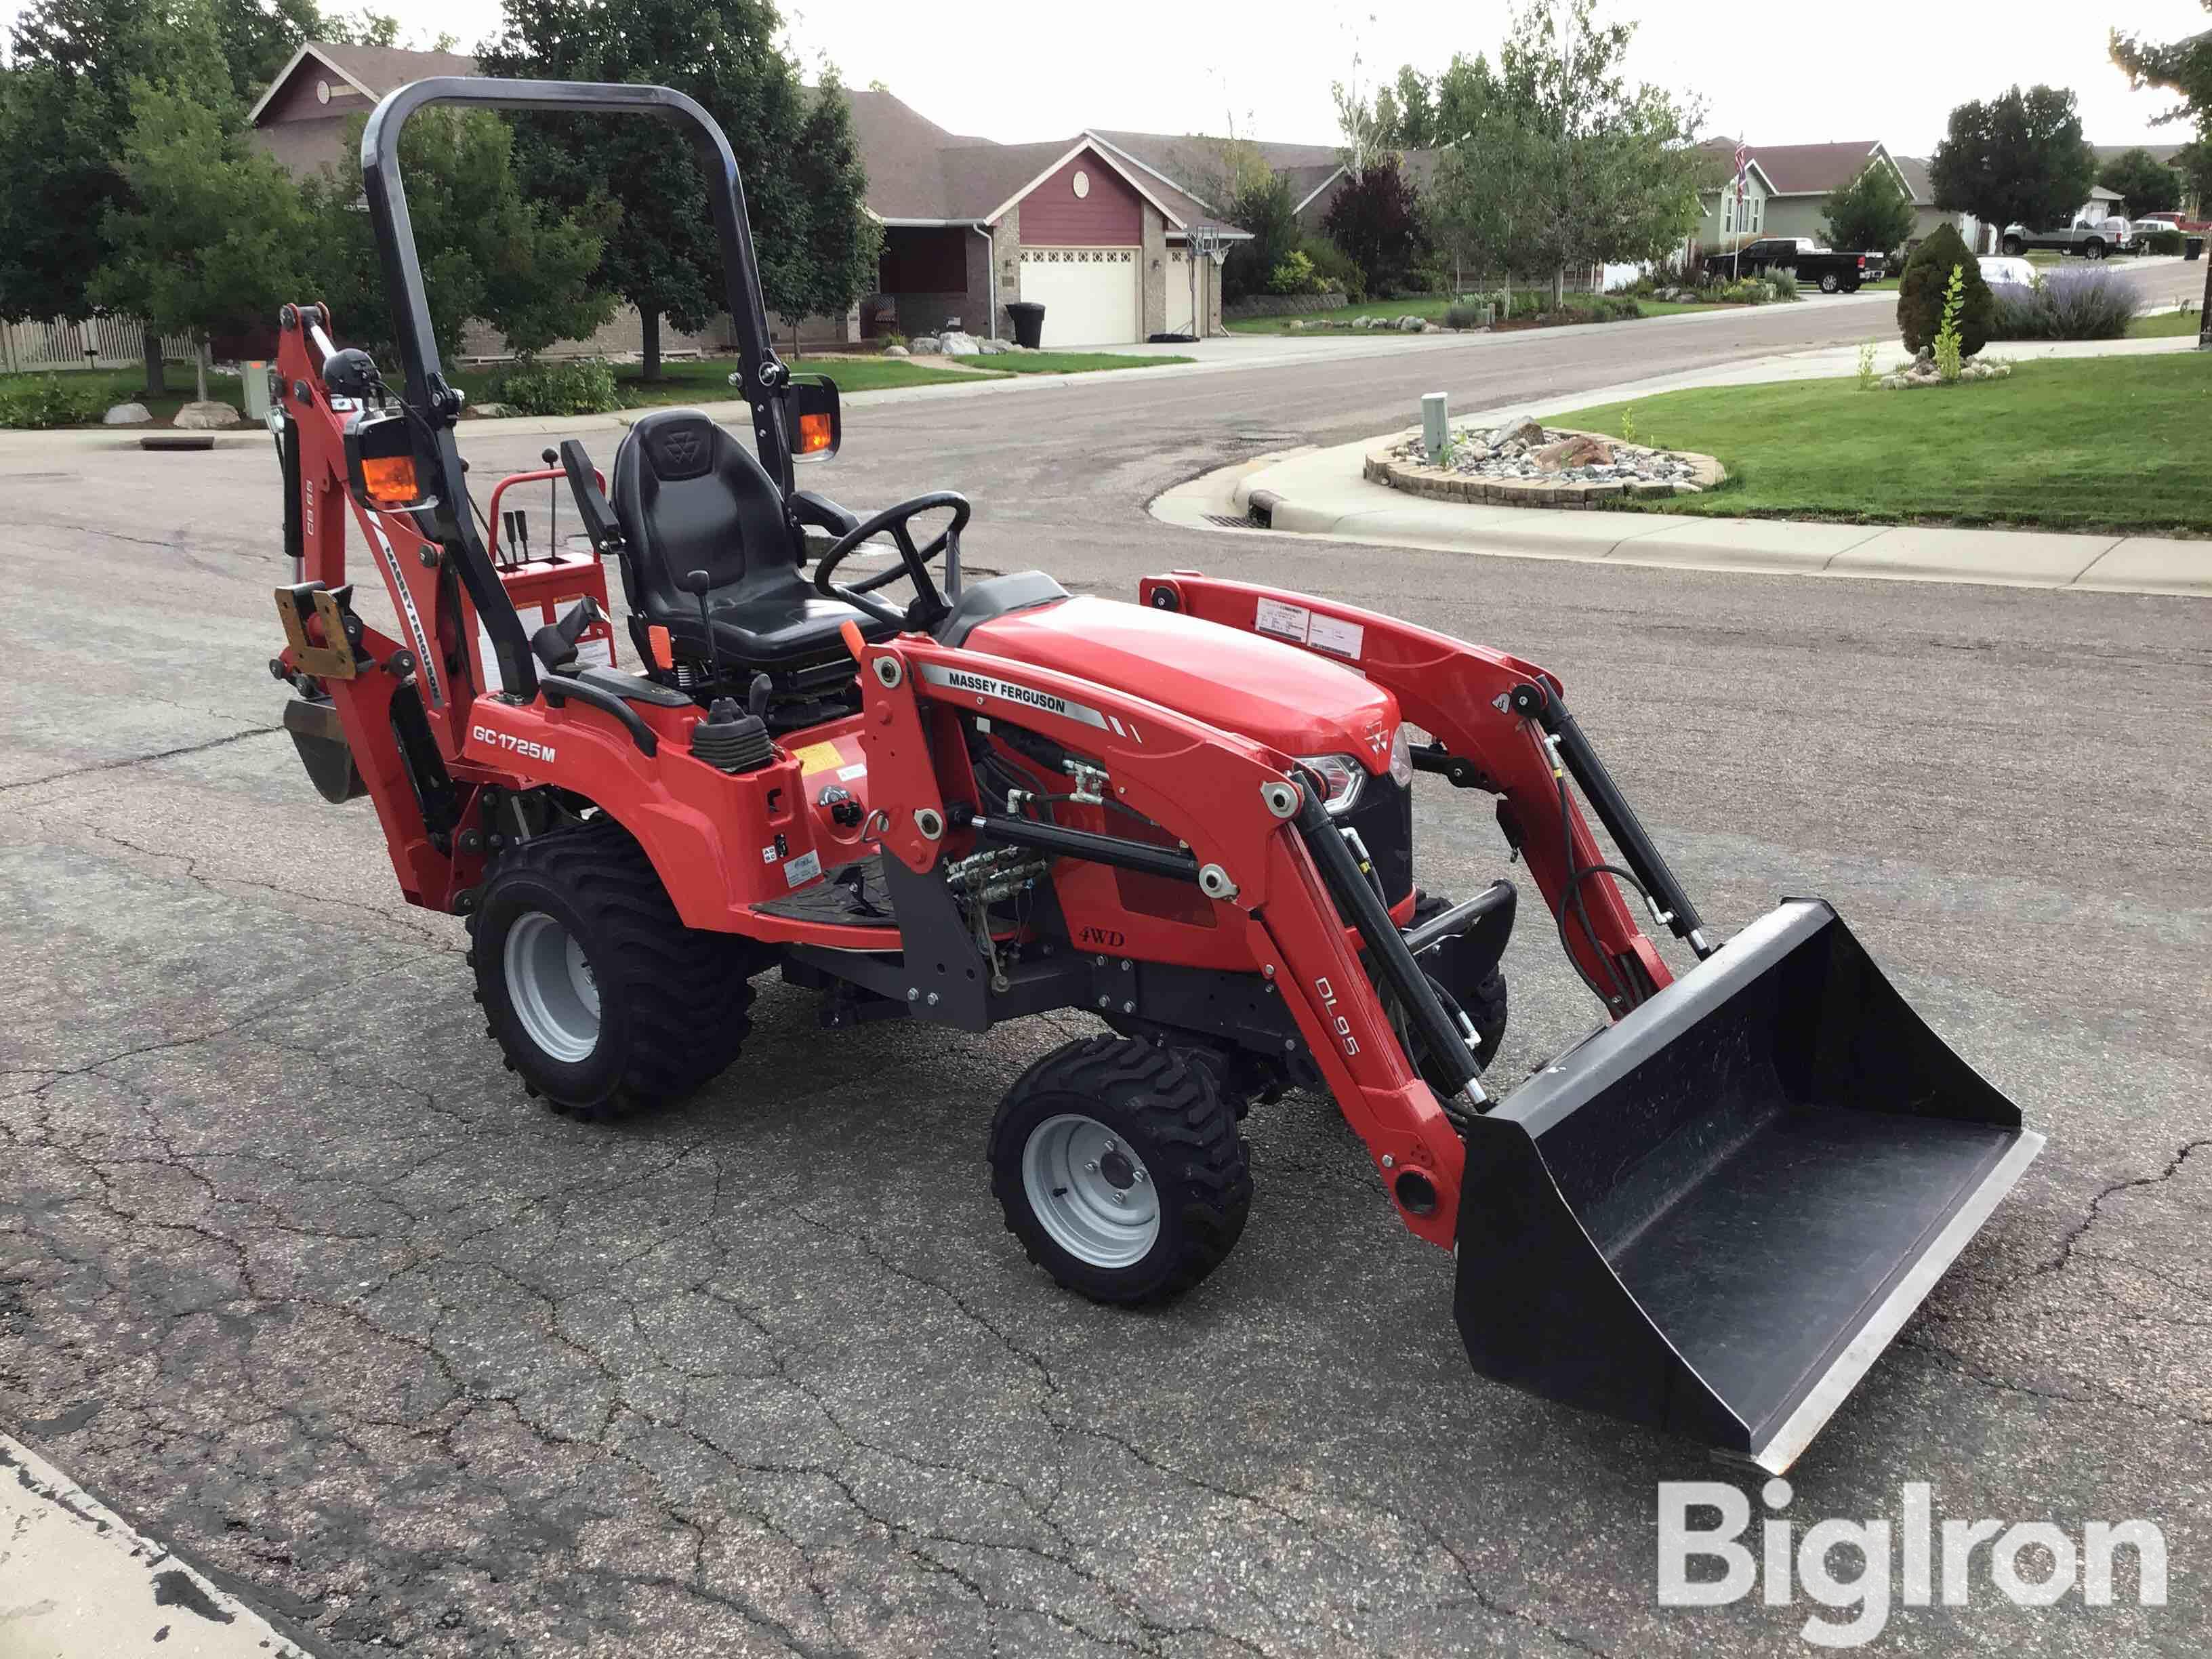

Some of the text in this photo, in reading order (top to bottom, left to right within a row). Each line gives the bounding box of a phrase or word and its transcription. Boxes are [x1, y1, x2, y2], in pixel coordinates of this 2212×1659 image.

[385, 547, 441, 699] MASSEY FERGUSON
[949, 672, 1065, 713] MASSEY FERGUSON
[473, 725, 556, 763] GC1725M
[1078, 926, 1124, 947] 4WD
[1315, 977, 1361, 1055] DL95
